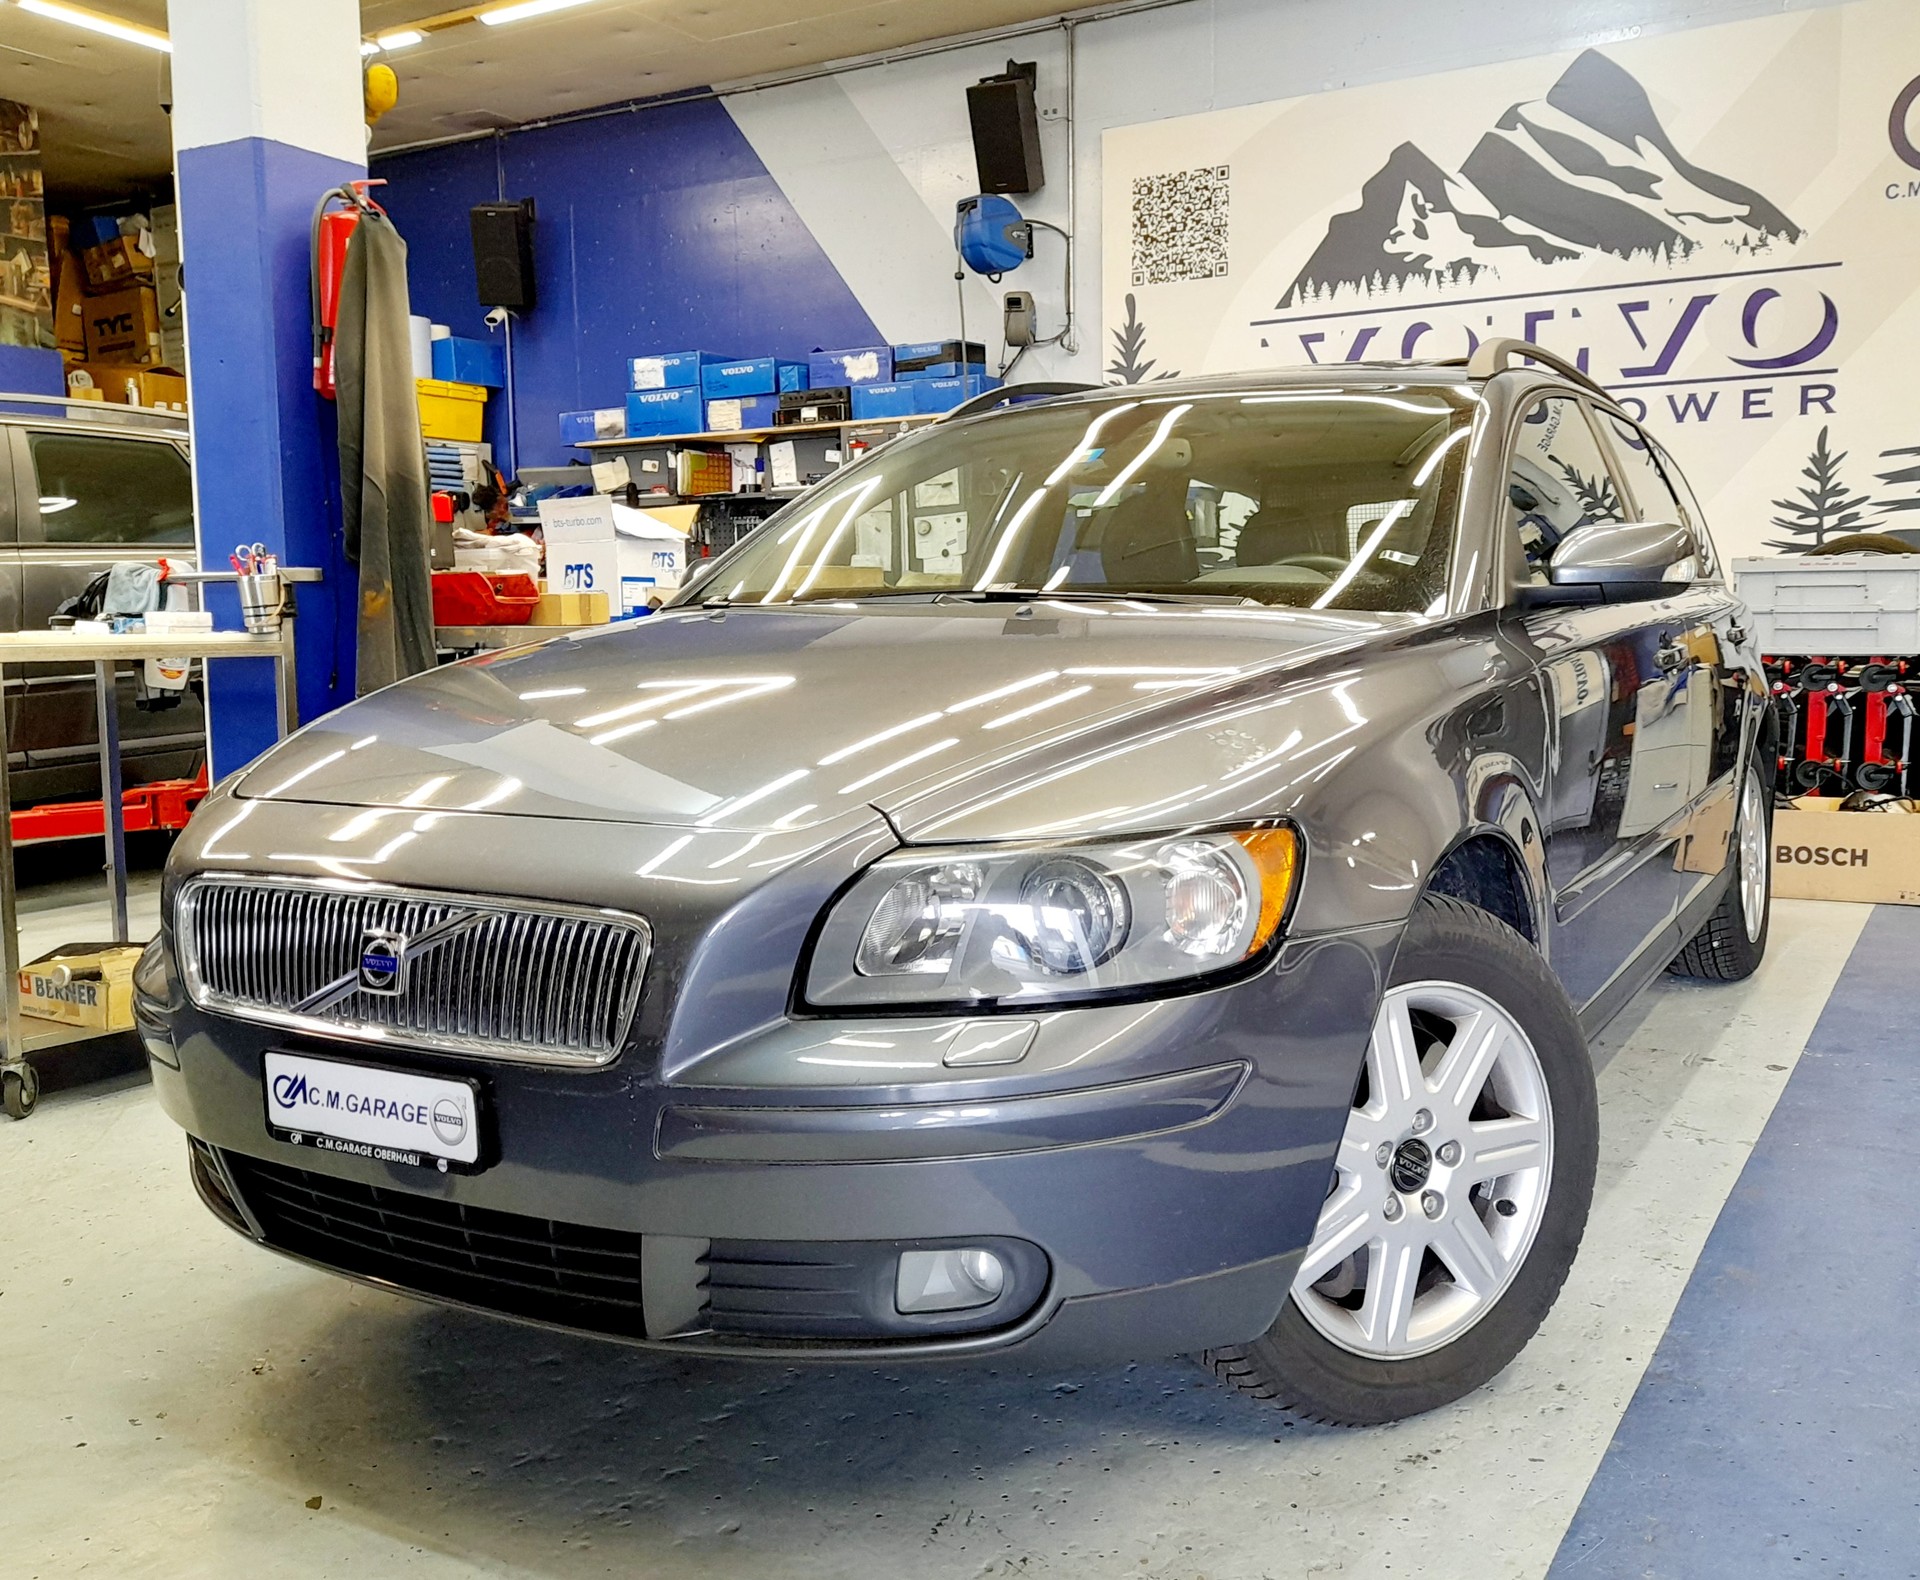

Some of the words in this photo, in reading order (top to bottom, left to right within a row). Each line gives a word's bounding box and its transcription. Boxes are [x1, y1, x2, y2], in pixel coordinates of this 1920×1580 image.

[93, 313, 134, 336] TYC
[721, 365, 754, 376] VOLVO
[868, 386, 897, 395] VOLVO
[932, 380, 960, 389] VOLVO
[640, 391, 680, 403] VOLVO
[1616, 384, 1839, 425] OWER
[553, 516, 603, 528] bts-turbo.com
[1775, 845, 1869, 867] BOSCH
[364, 957, 393, 968] VOLVO
[308, 1086, 429, 1126] C.M.GARAGE
[434, 1114, 463, 1126] VOLVO
[316, 1137, 373, 1157] C.M.GARAGE
[374, 1148, 420, 1167] OBERHASLI
[1399, 1158, 1429, 1177] VOLVO
